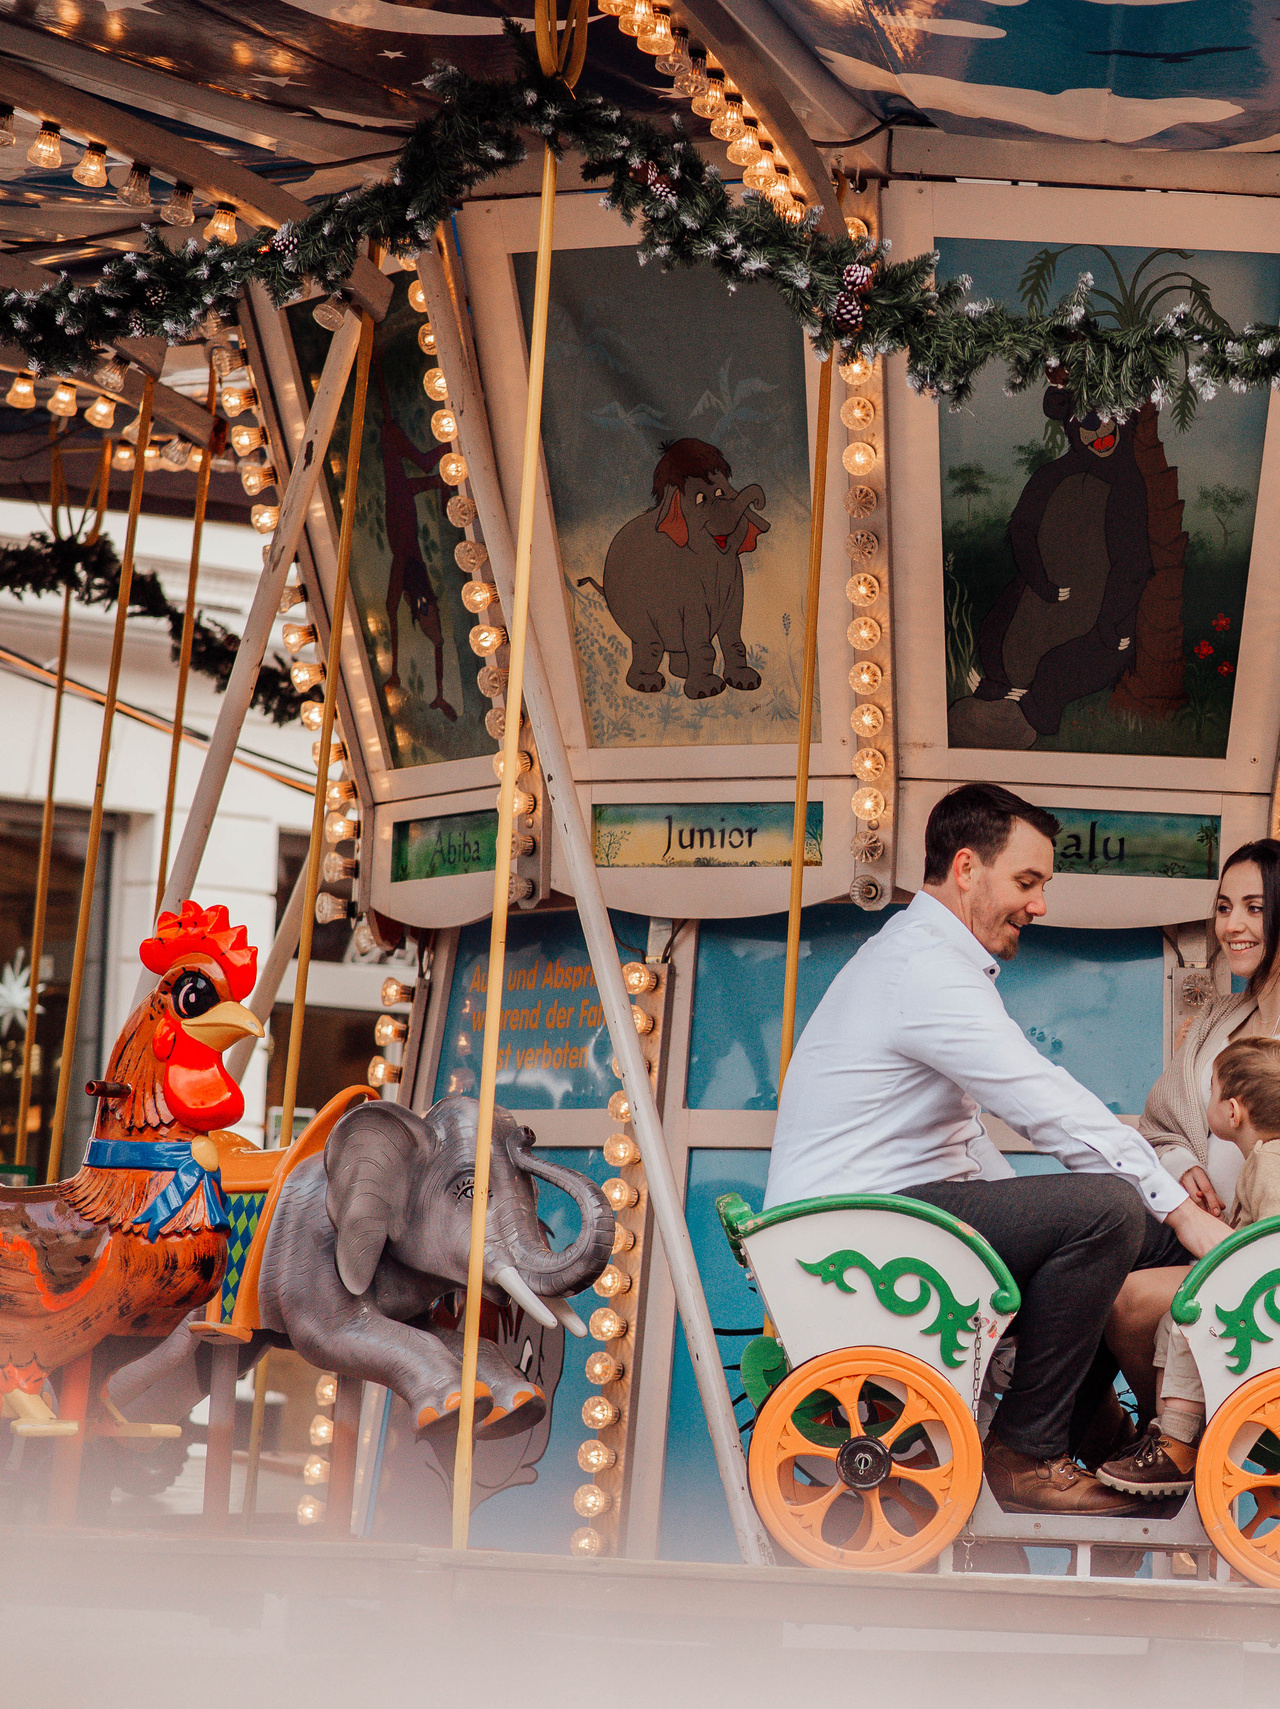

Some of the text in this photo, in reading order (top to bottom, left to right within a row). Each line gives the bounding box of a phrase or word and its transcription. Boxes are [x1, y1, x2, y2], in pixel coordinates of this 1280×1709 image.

[431, 830, 481, 865] Abiba
[663, 815, 757, 858] Junior
[1054, 821, 1124, 862] alu
[468, 957, 598, 993] Au und Abspri
[472, 999, 606, 1032] wrend der Fah
[495, 1039, 589, 1071] st verboten
